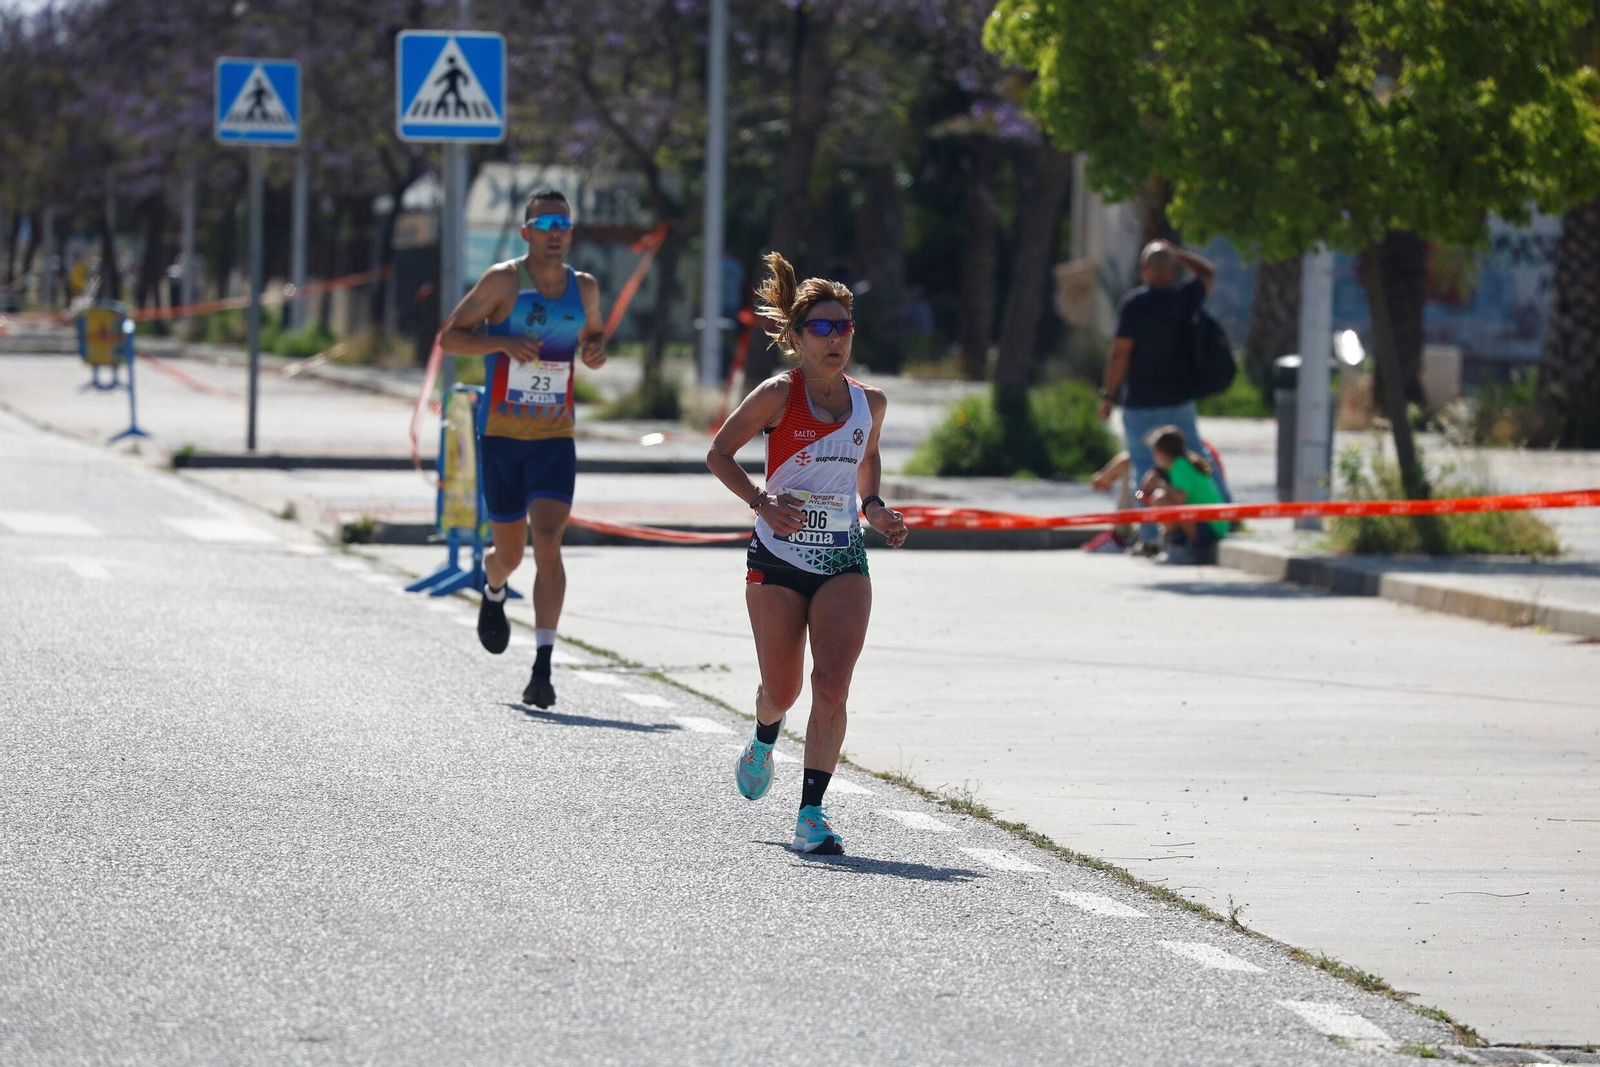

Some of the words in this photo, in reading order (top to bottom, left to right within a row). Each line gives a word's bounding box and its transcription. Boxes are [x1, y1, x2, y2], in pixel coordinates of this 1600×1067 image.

[530, 376, 551, 391] 23
[519, 392, 556, 403] Joma
[793, 430, 816, 438] SALTO
[815, 455, 838, 464] super
